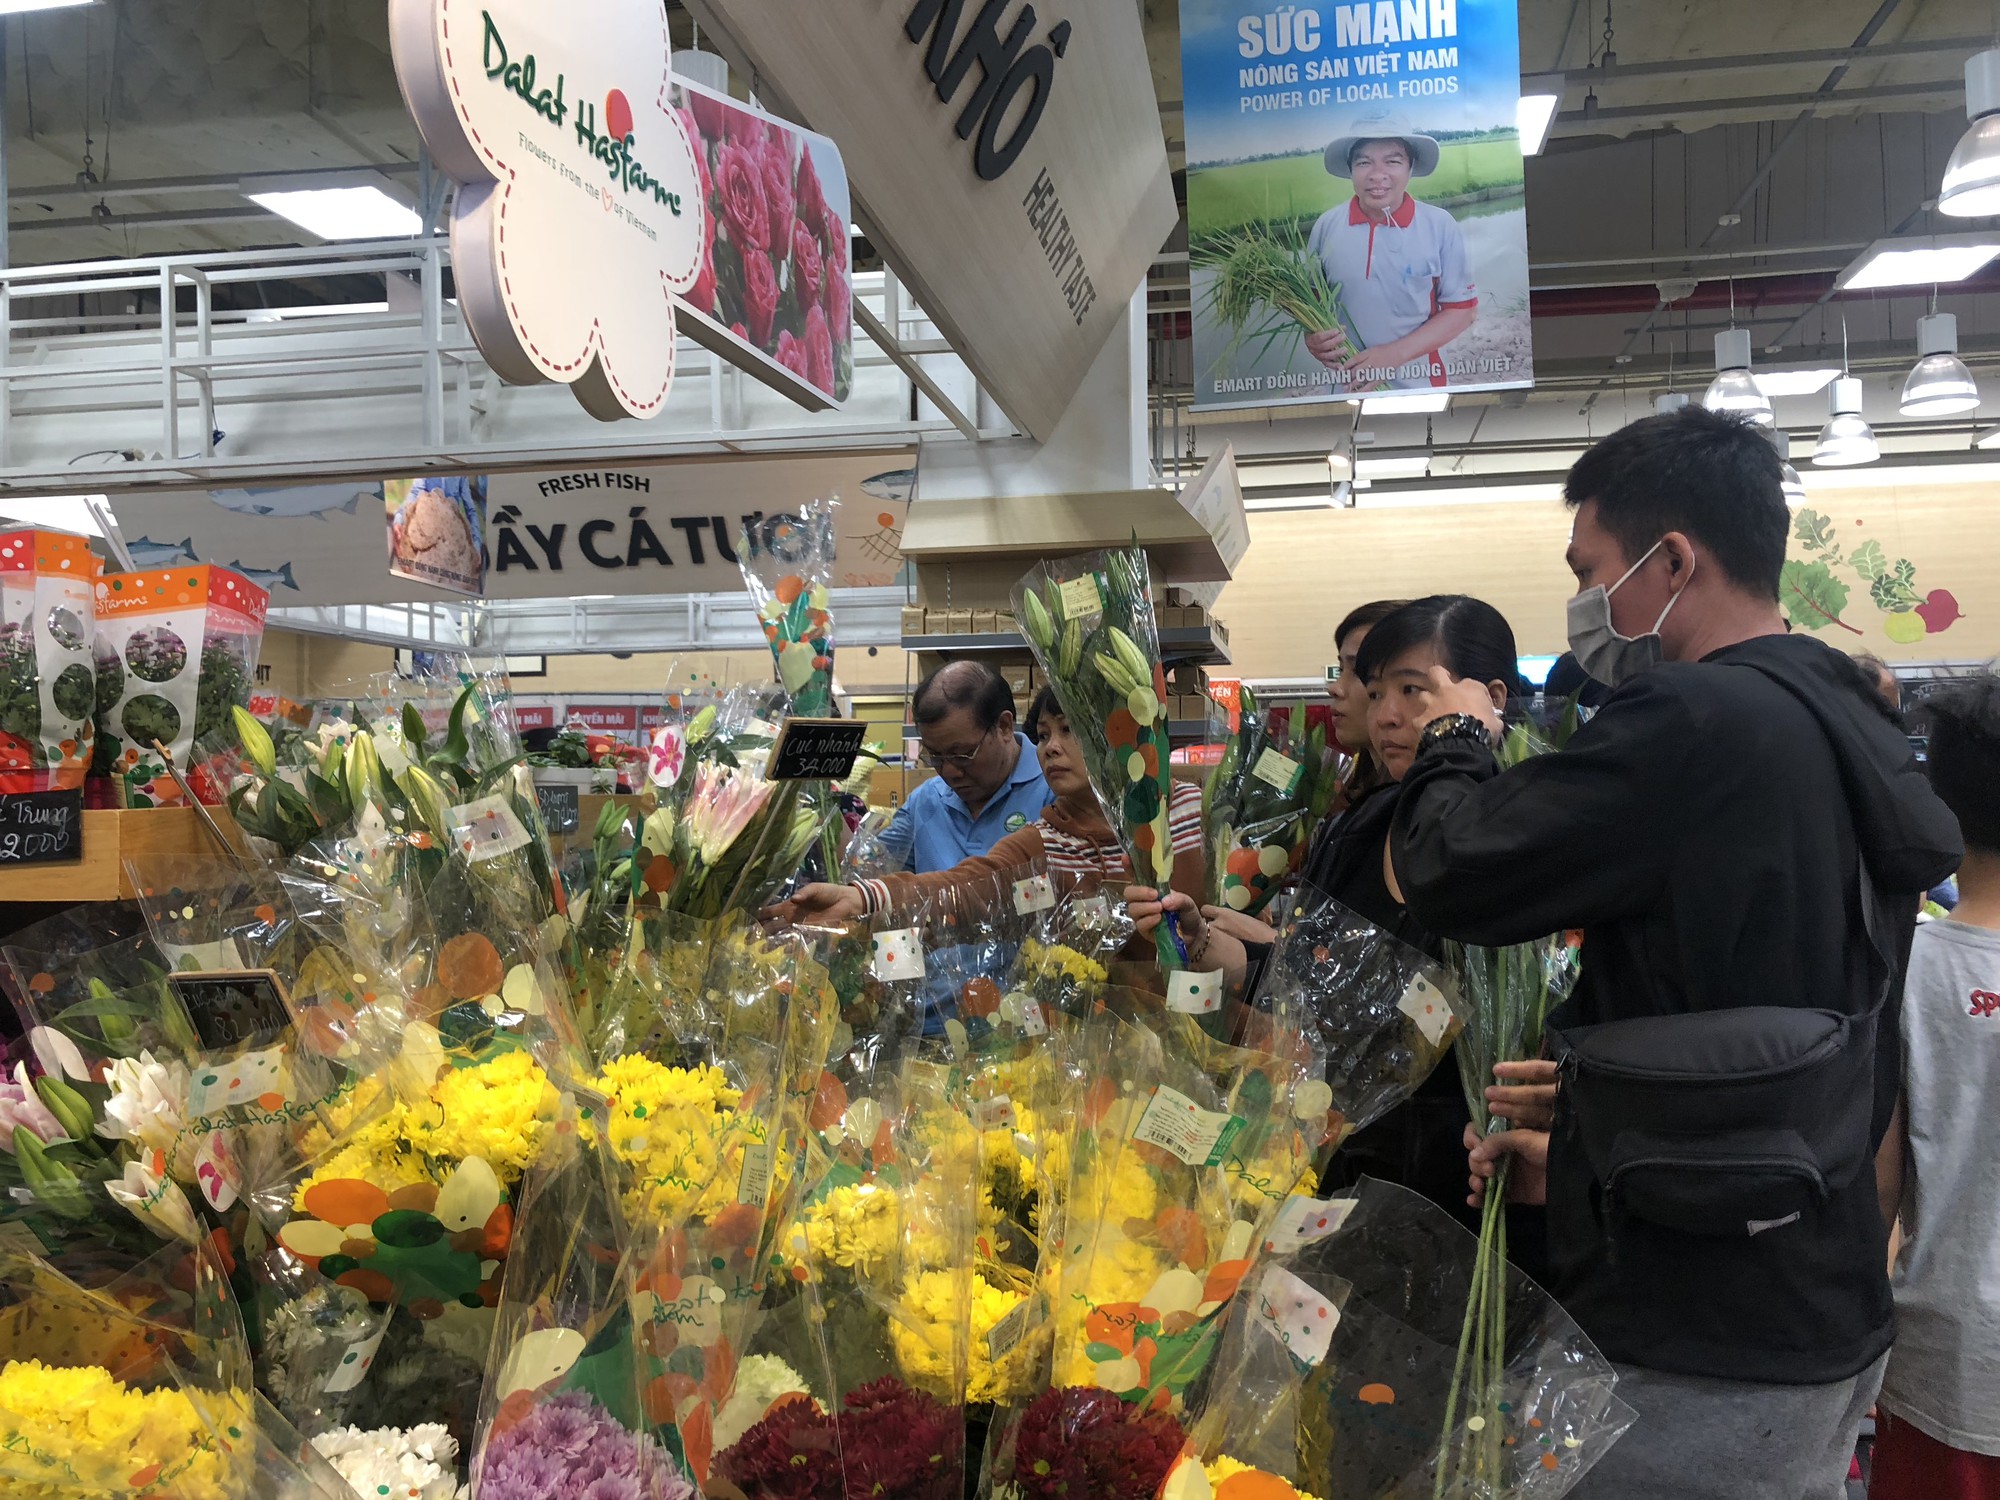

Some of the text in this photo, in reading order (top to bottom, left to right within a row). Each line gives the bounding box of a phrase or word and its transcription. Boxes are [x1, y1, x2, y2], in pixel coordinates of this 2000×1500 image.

[1237, 0, 1457, 58] SỨC MẠNH
[1239, 61, 1298, 88] NÔNG
[1355, 50, 1401, 77] VIỆT
[1408, 47, 1458, 71] NAM
[1240, 76, 1458, 113] POWER OF LOCAL FOODS
[482, 9, 681, 216] Dalat Hasfarm
[518, 131, 557, 171] Flowers
[584, 181, 600, 201] the
[613, 202, 623, 218] of
[626, 208, 657, 242] Vietnam
[1023, 165, 1096, 327] HEALTHY TASTE
[1213, 376, 1263, 394] EMART
[1266, 368, 1307, 389] ĐỒNG
[1311, 367, 1351, 385] HÀNH
[1355, 364, 1396, 383] CÙNG
[1400, 361, 1441, 379] NÔNG
[537, 473, 650, 498] FRESH FISH
[484, 505, 567, 572] ẦY
[578, 506, 674, 568] CÁ
